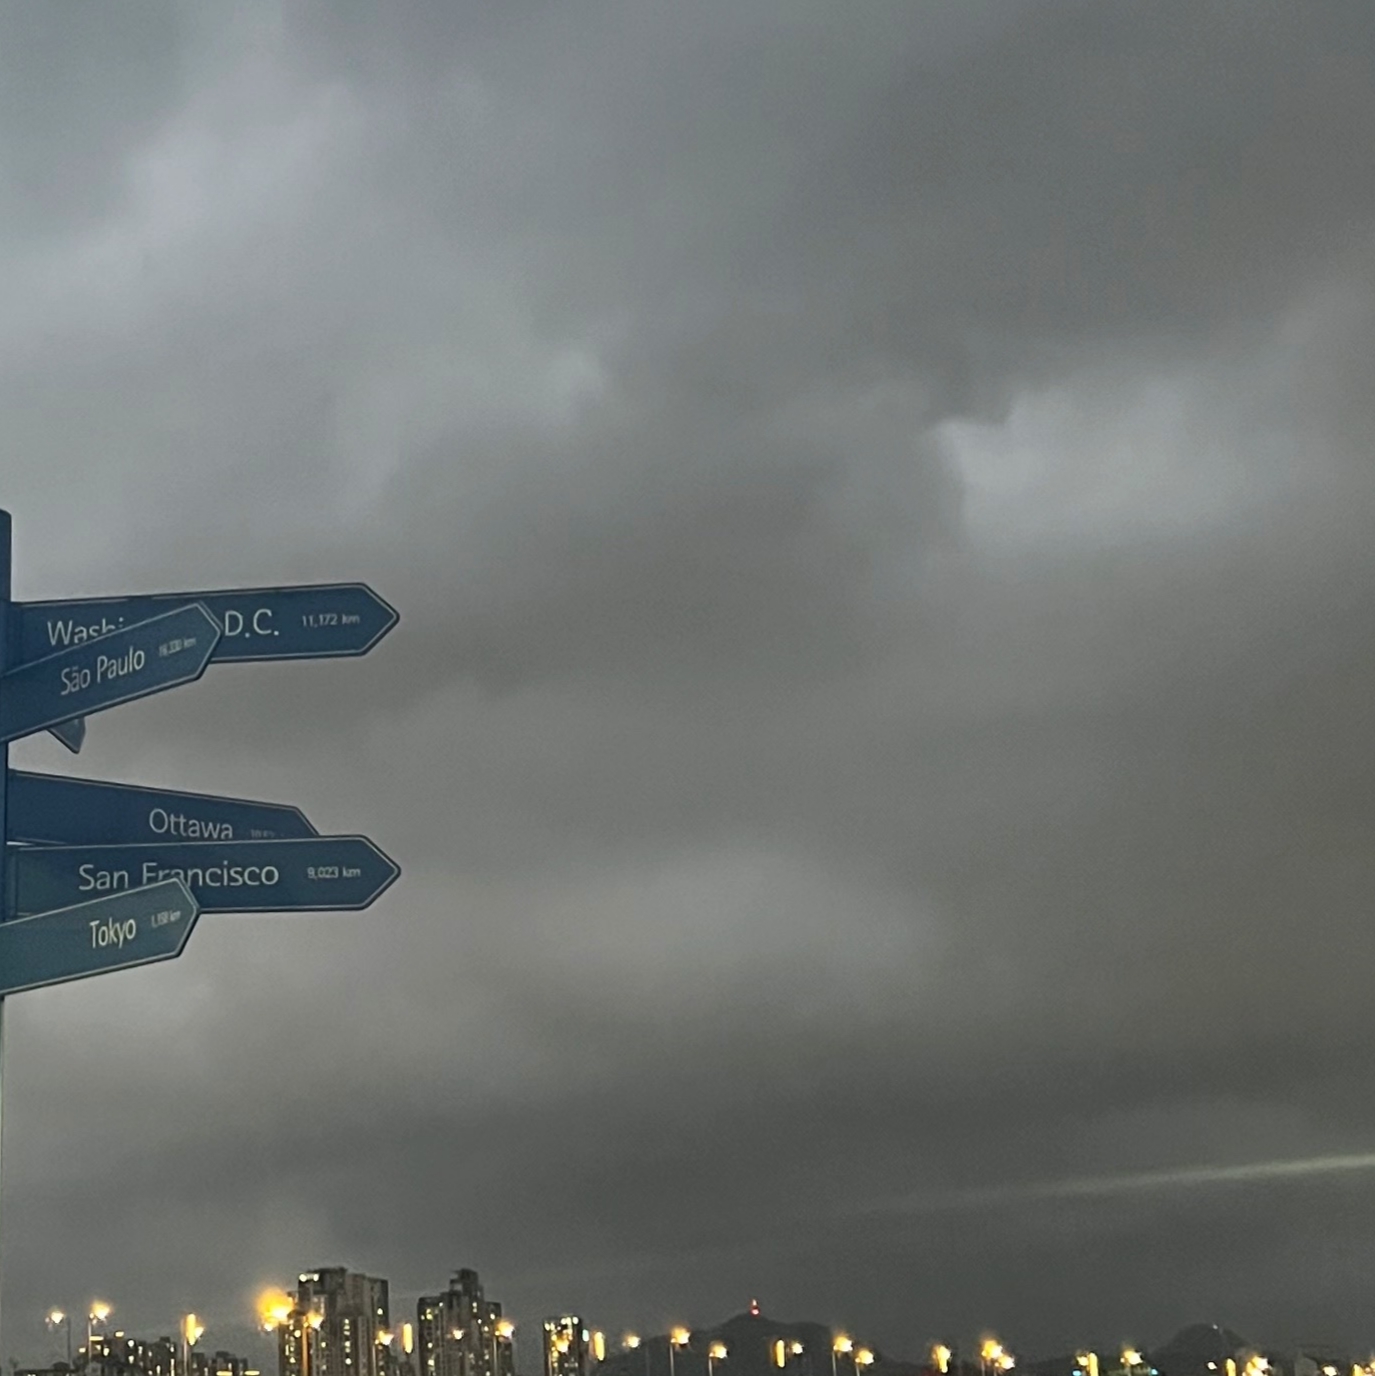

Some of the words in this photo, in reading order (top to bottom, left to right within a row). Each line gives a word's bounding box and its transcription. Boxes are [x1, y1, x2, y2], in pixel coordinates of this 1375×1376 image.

[224, 609, 280, 637] D.C.
[341, 613, 361, 625] km
[96, 645, 146, 684] Paulo
[148, 807, 234, 840] Ottawa
[78, 863, 129, 891] San
[142, 860, 280, 888] Francisco
[342, 867, 362, 878] km
[89, 917, 137, 950] Tokyo
